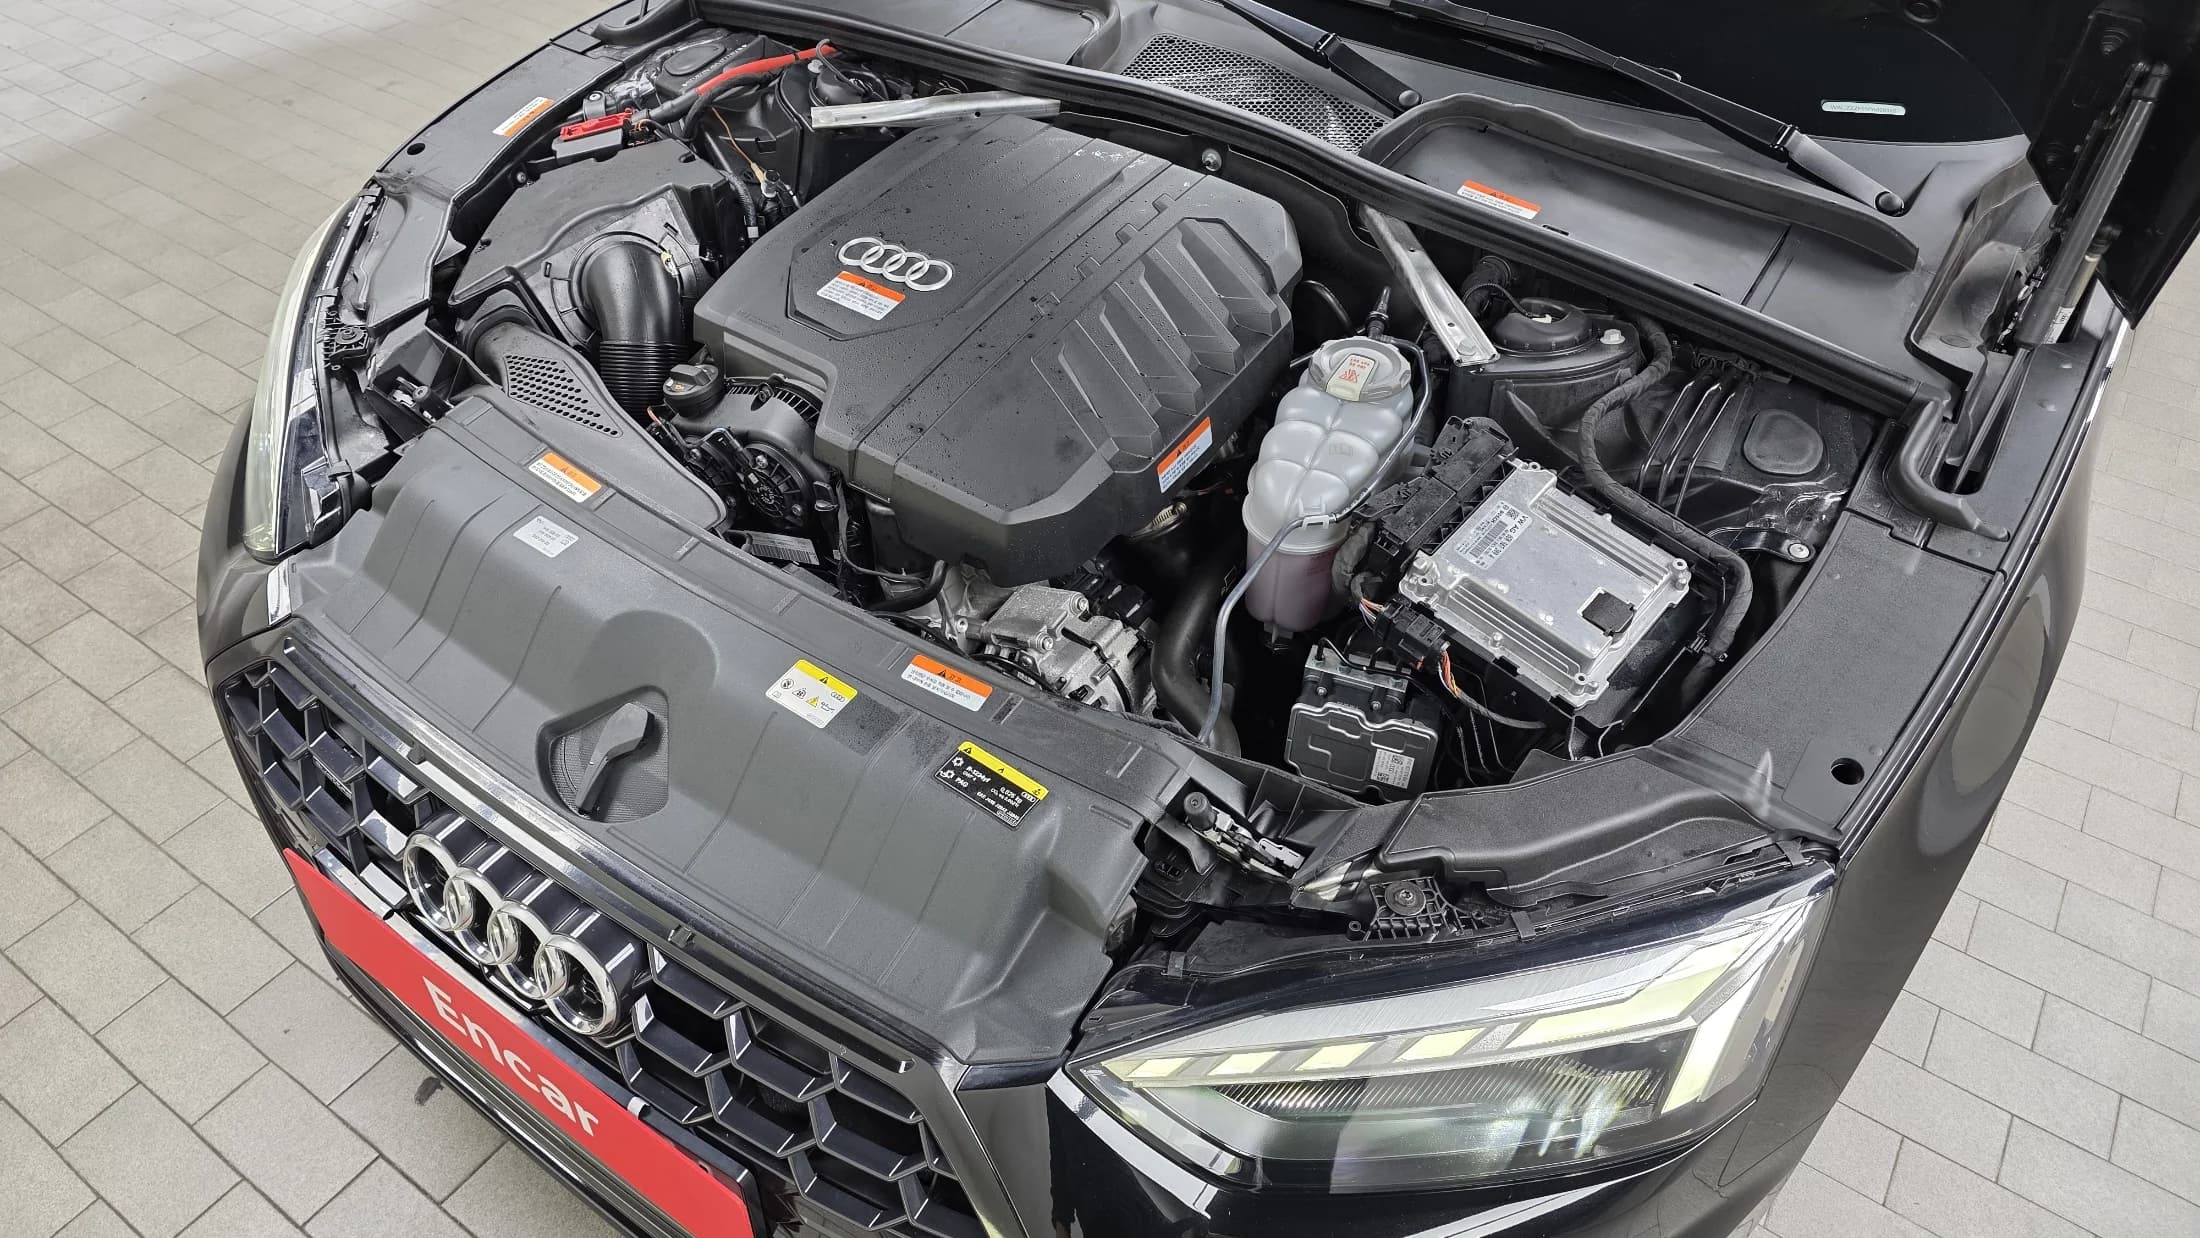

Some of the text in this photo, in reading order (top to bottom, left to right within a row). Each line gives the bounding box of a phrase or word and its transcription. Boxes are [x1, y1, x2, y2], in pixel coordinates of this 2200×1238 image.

[1510, 515, 1529, 533] VW AG
[955, 777, 969, 788] PAG
[422, 976, 599, 1136] Encar
